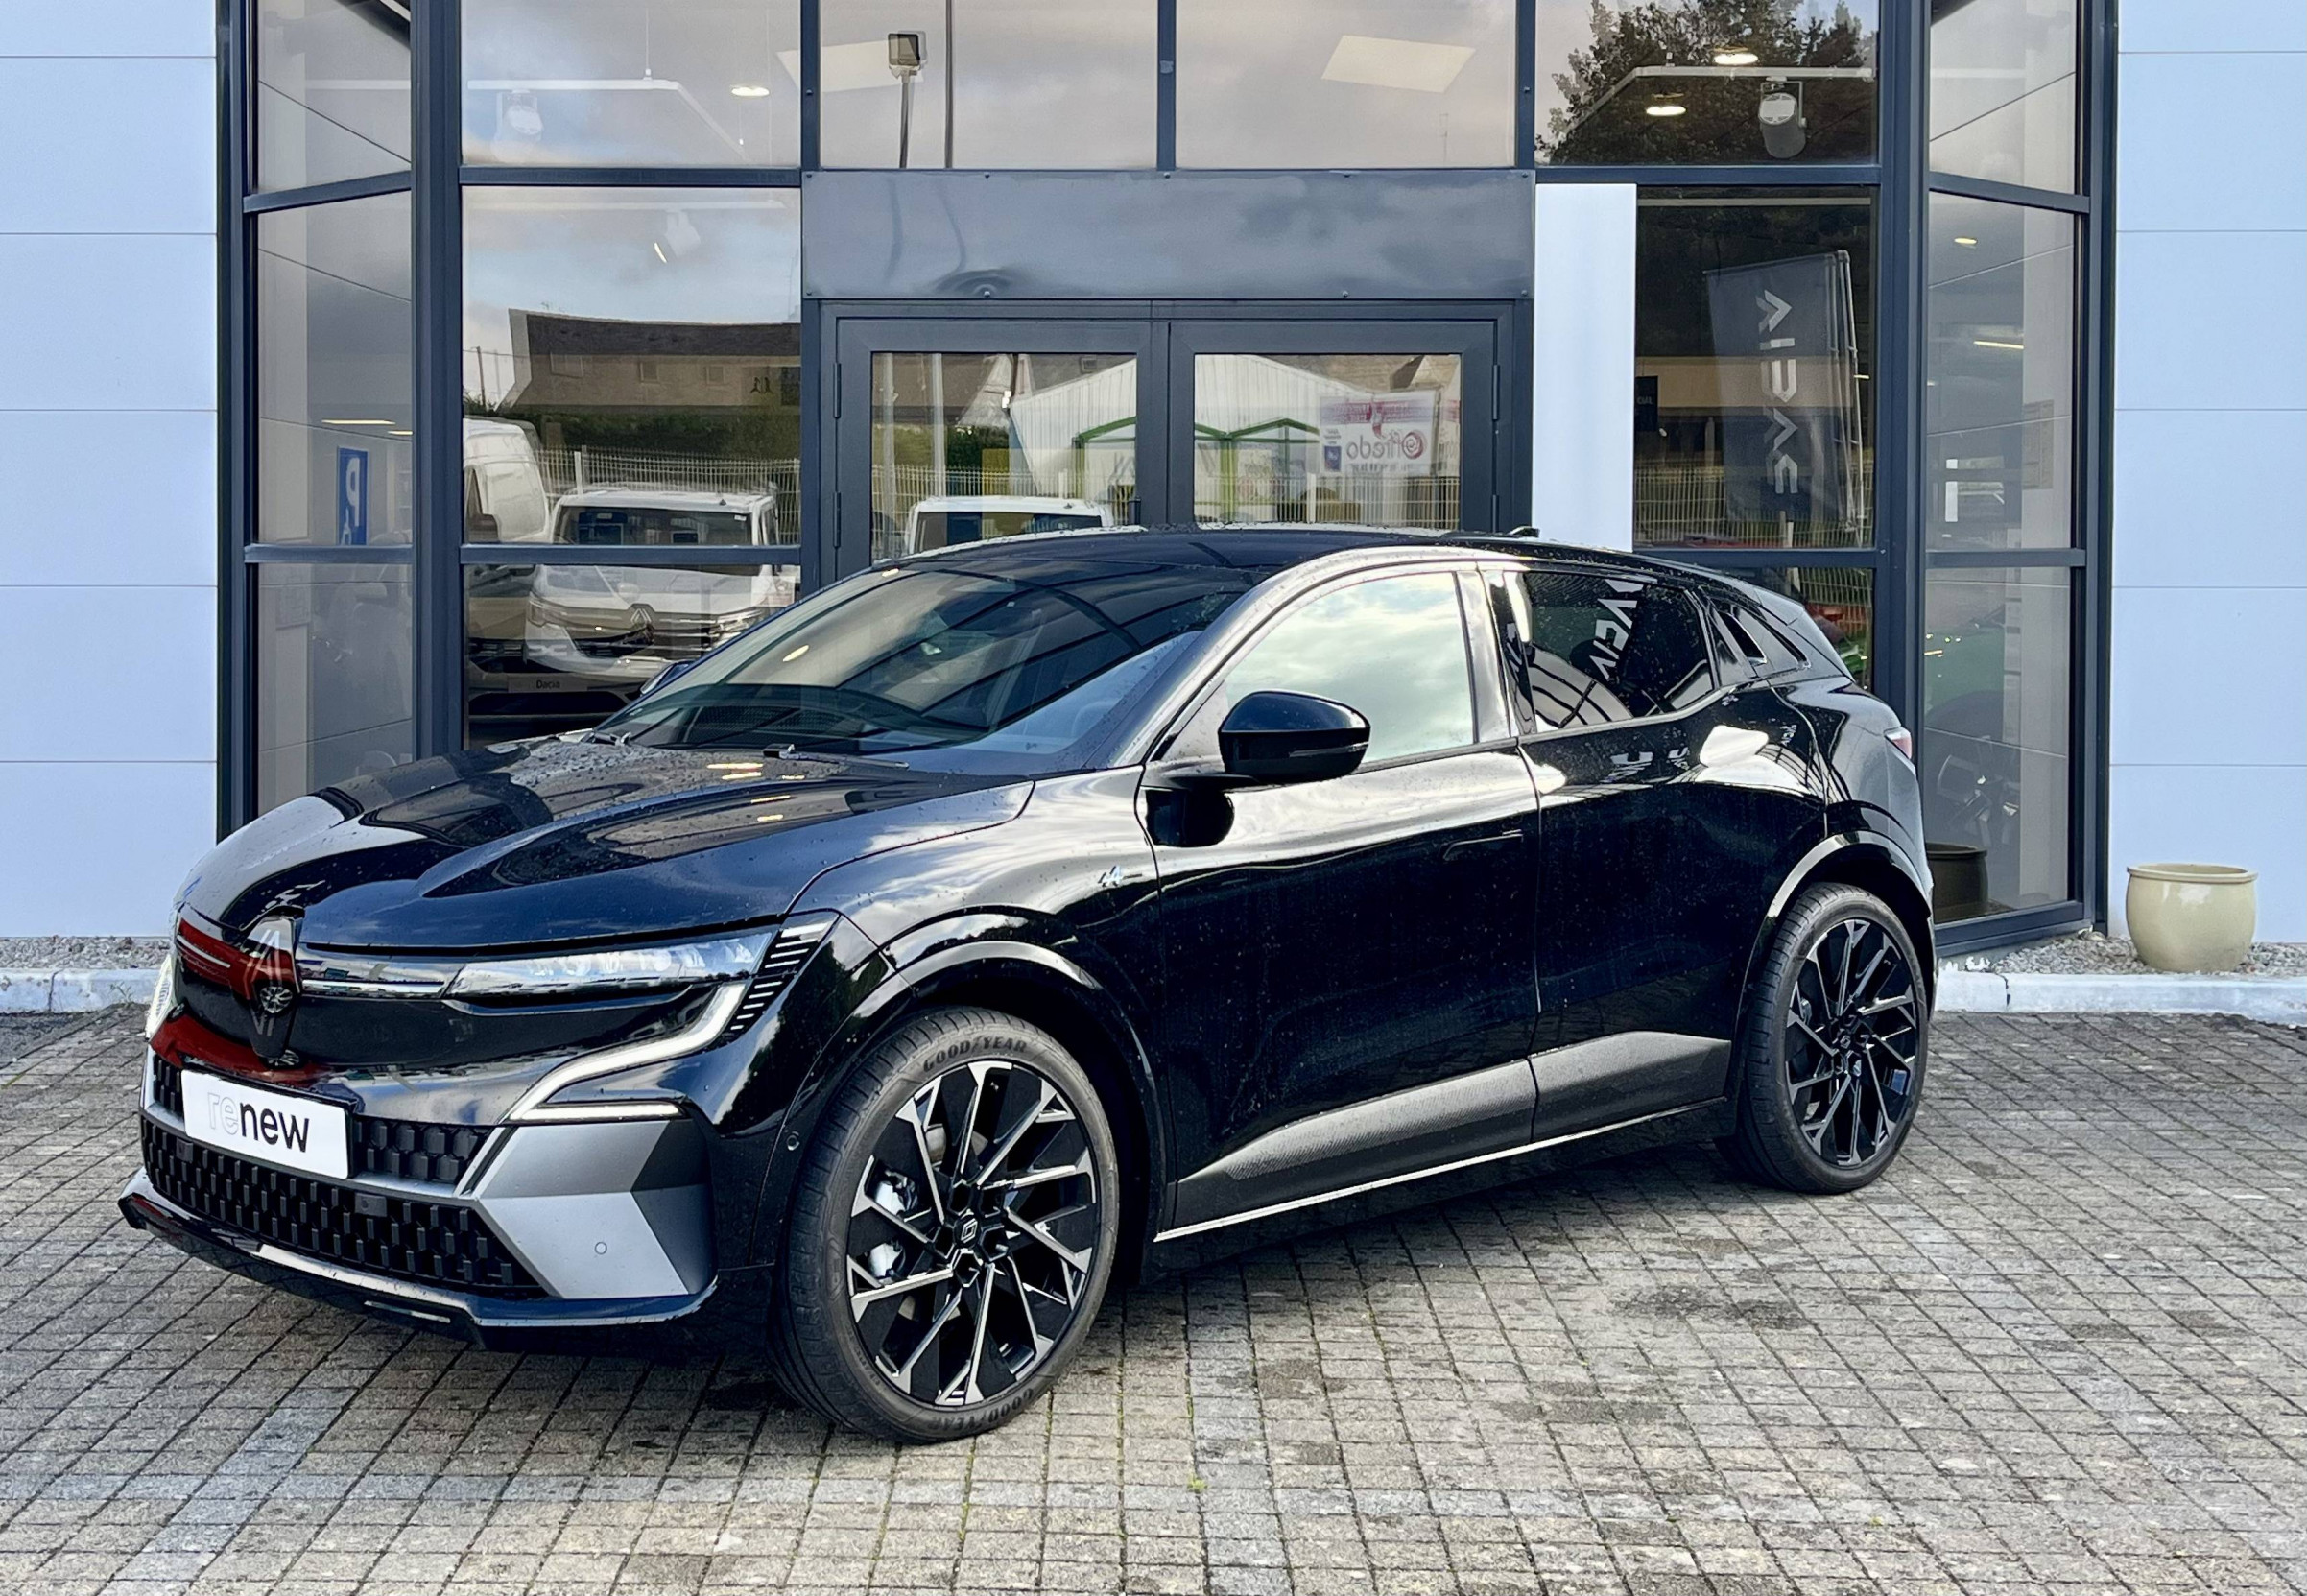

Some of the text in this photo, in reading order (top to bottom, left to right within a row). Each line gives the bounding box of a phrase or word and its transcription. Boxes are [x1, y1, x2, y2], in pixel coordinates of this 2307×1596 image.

[535, 679, 560, 689] Dacia
[923, 1035, 1028, 1073] GOODYEAR
[207, 1092, 310, 1153] renew
